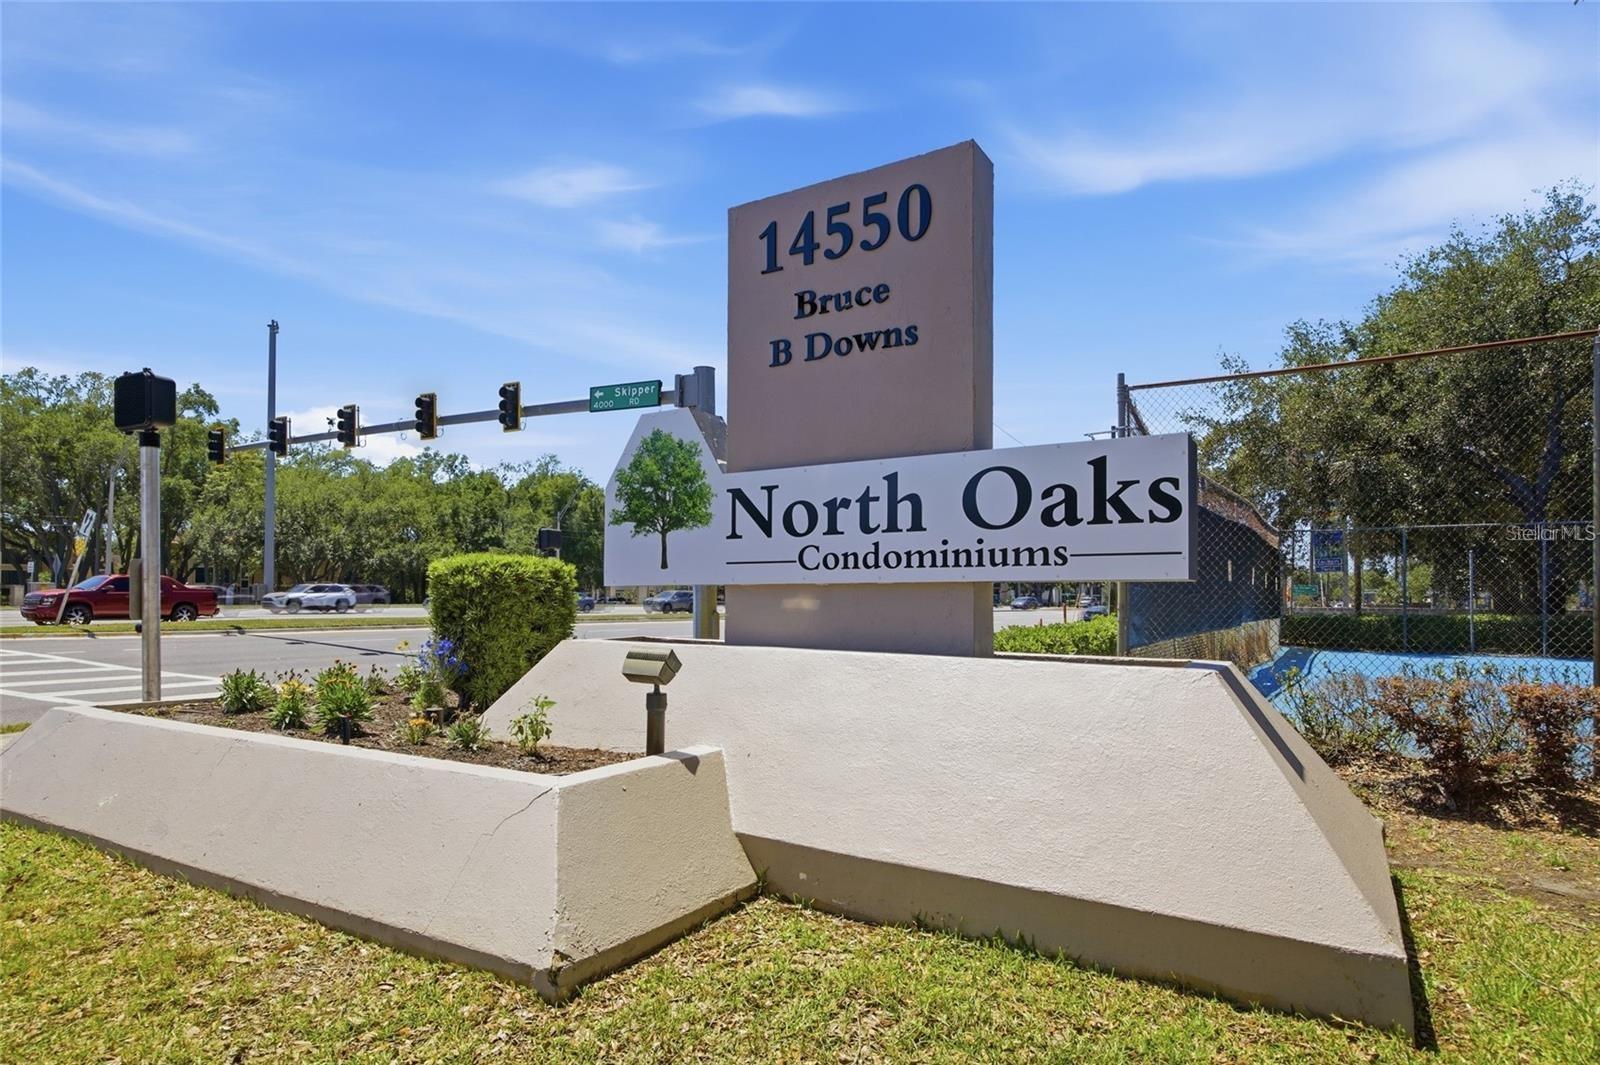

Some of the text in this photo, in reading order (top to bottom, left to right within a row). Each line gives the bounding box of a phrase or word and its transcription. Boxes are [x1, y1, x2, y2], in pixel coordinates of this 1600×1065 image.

[758, 183, 933, 275] 14550
[793, 282, 890, 319] Bruce
[769, 324, 919, 368] B Downs
[593, 397, 640, 409] 4000 RD
[614, 385, 656, 397] Skipper
[726, 455, 1183, 540] North Oaks
[797, 538, 1068, 571] Condominiums
